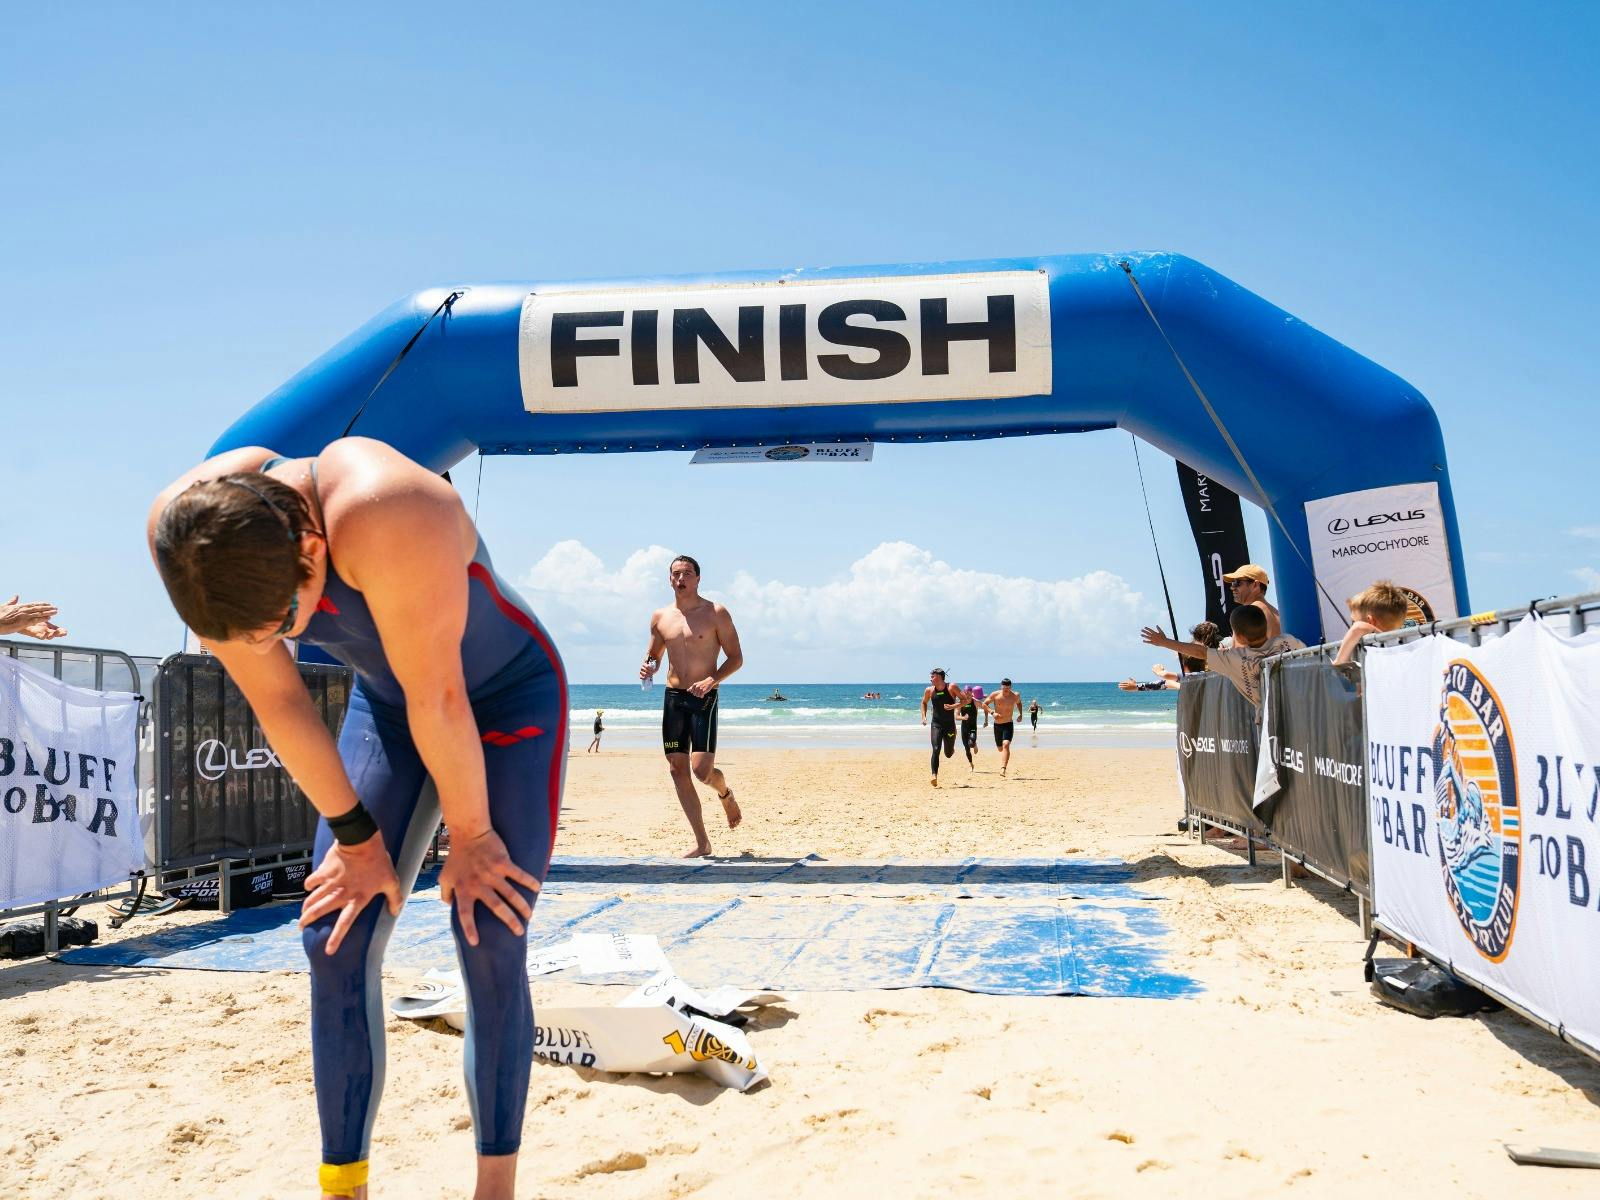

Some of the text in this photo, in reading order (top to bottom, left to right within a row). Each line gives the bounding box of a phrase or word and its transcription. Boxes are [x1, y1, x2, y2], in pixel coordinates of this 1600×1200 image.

[551, 295, 1017, 388] FINISH
[1354, 508, 1426, 528] LEXUS
[1332, 535, 1430, 559] MAROOCHYDORE
[1407, 591, 1425, 608] BAR
[1452, 665, 1504, 746] TO BAR
[230, 748, 282, 770] LEX
[1370, 742, 1433, 794] BLUFF
[1382, 797, 1430, 857] BAR
[179, 888, 220, 897] SPOR
[254, 879, 273, 891] SPOR
[1493, 882, 1515, 945] CLUB
